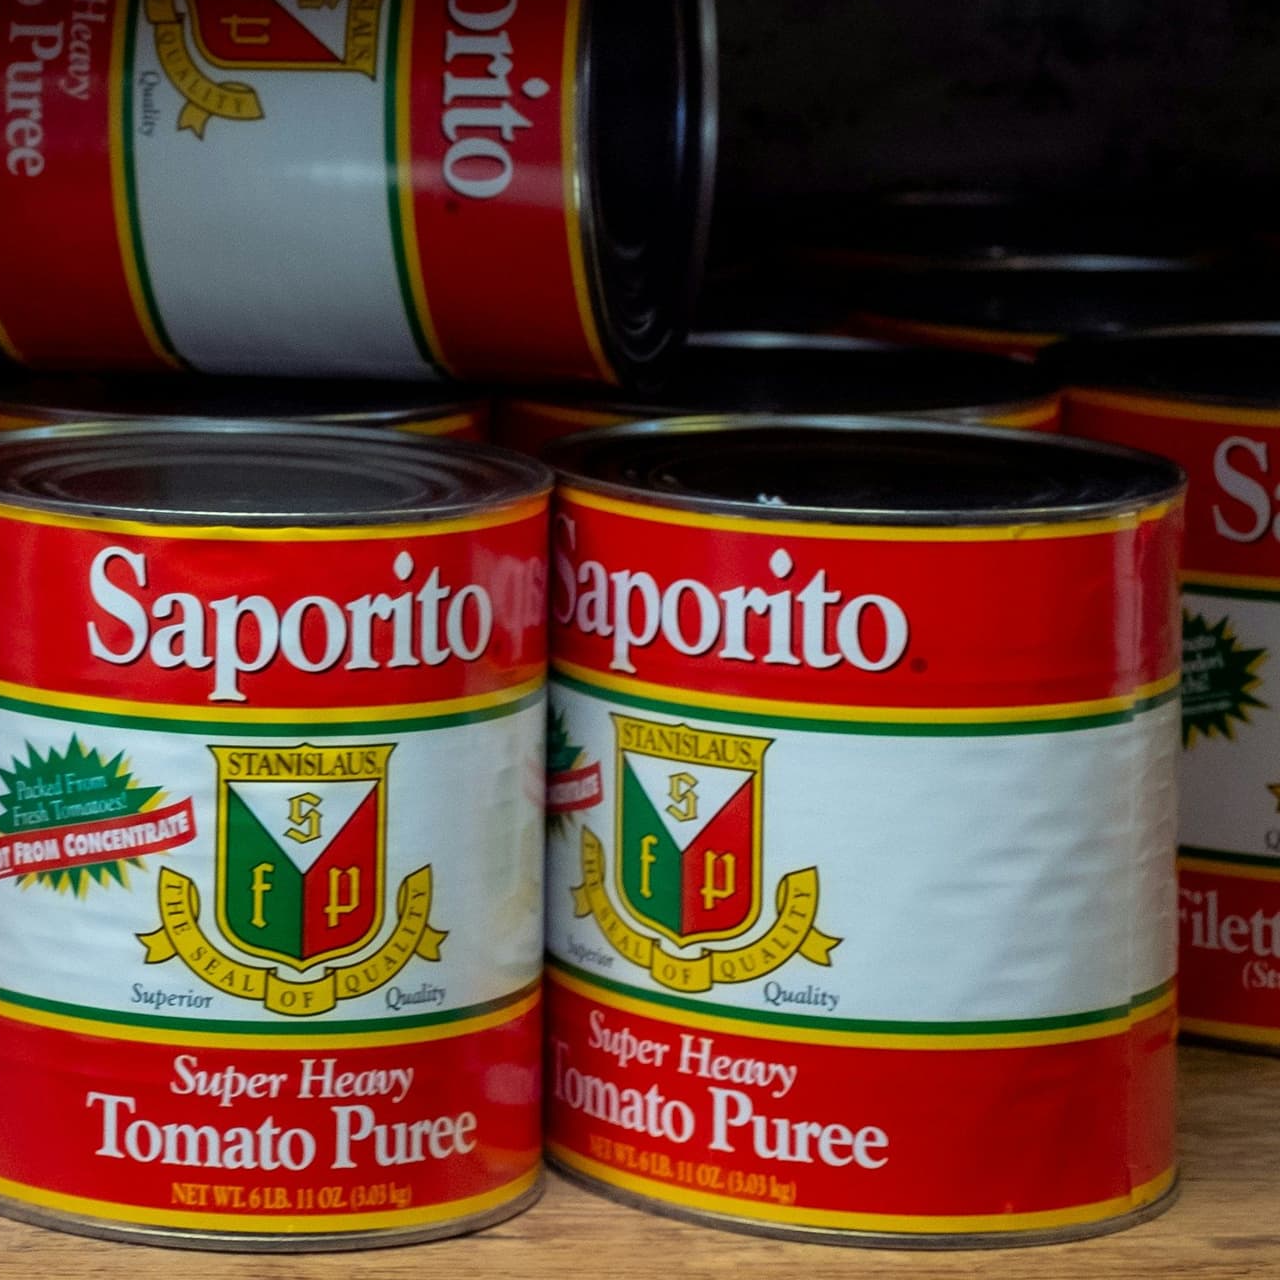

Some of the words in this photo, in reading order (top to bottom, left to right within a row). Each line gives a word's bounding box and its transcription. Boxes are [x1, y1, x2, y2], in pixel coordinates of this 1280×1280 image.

[5, 21, 65, 178] Puree
[87, 546, 493, 703] Saporito
[227, 751, 379, 776] STANISLAUS
[623, 722, 756, 766] STANISLAUS
[13, 839, 60, 865] FROM
[65, 815, 189, 857] CONCENTRATE
[131, 982, 213, 1009] Superior
[385, 983, 445, 1011] Quality
[763, 982, 839, 1009] Quality
[170, 1055, 286, 1102] Super
[300, 1059, 414, 1103] Heavy
[589, 1011, 670, 1068] Super
[678, 1035, 797, 1097] Heavy
[87, 1093, 316, 1171] Tomato
[330, 1105, 478, 1170] Puree
[709, 1085, 890, 1168] Puree
